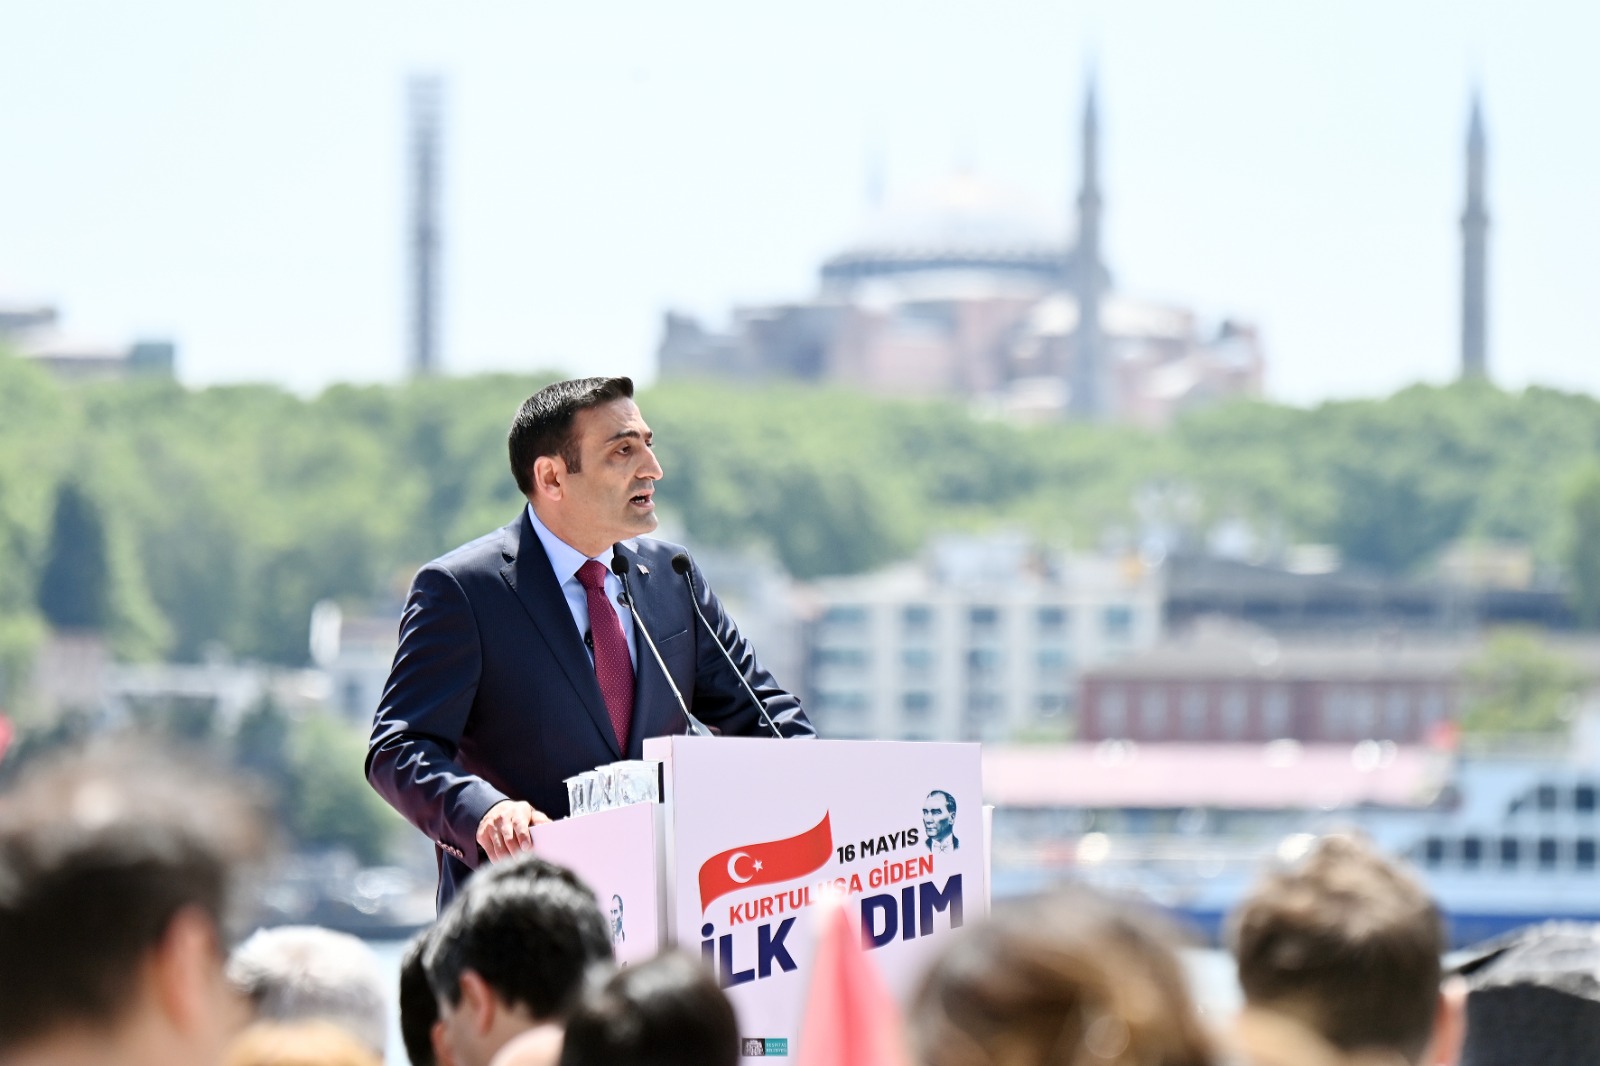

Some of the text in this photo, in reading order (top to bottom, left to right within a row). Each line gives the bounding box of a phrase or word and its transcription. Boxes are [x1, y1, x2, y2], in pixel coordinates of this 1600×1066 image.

[837, 828, 919, 865] 16 MAYIS
[868, 854, 934, 889] GİDEN
[701, 873, 963, 990] İLK DIM
